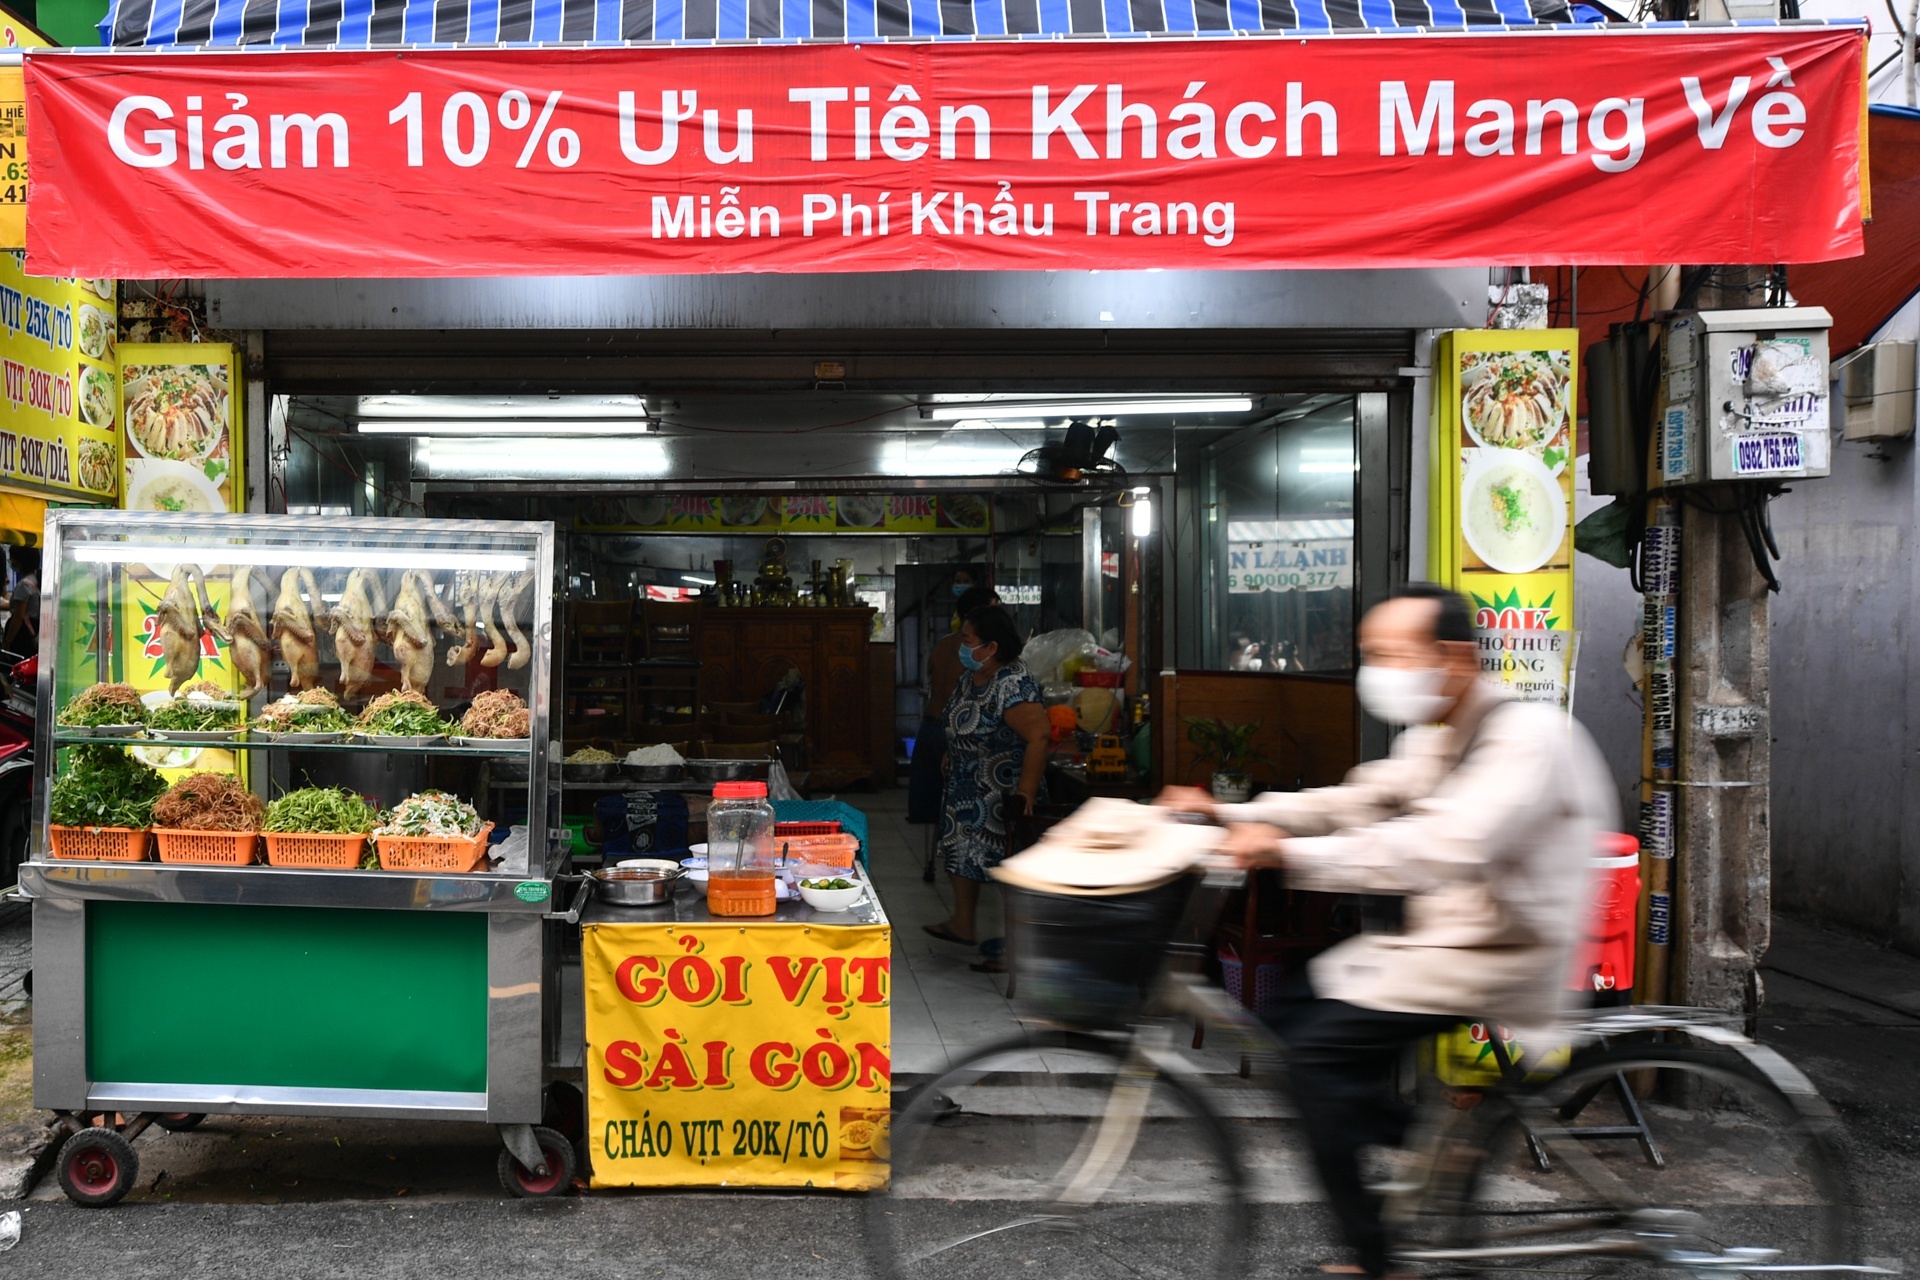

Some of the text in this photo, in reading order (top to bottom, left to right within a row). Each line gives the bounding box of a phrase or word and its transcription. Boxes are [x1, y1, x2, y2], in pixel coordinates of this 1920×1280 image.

[107, 57, 1807, 173] Giảm 10% Ưu Tiên Khách Mang Về
[651, 180, 1235, 247] Miễn Phí Khẩu Trang
[26, 297, 72, 350] 25K/TÔ
[3, 360, 72, 419] VỊT 30K/TÔ
[0, 430, 17, 477] ỊT
[1738, 436, 1800, 471] 0982.756.333
[785, 495, 830, 516] 25K
[888, 495, 934, 516] 30K
[1474, 635, 1562, 652] HO THUÊ
[1516, 679, 1555, 693] người
[615, 935, 890, 1020] GỎI VỊT
[604, 1028, 890, 1092] SÀI GÒN
[604, 1108, 829, 1165] CHÁO VỊT 20K/TÔ
